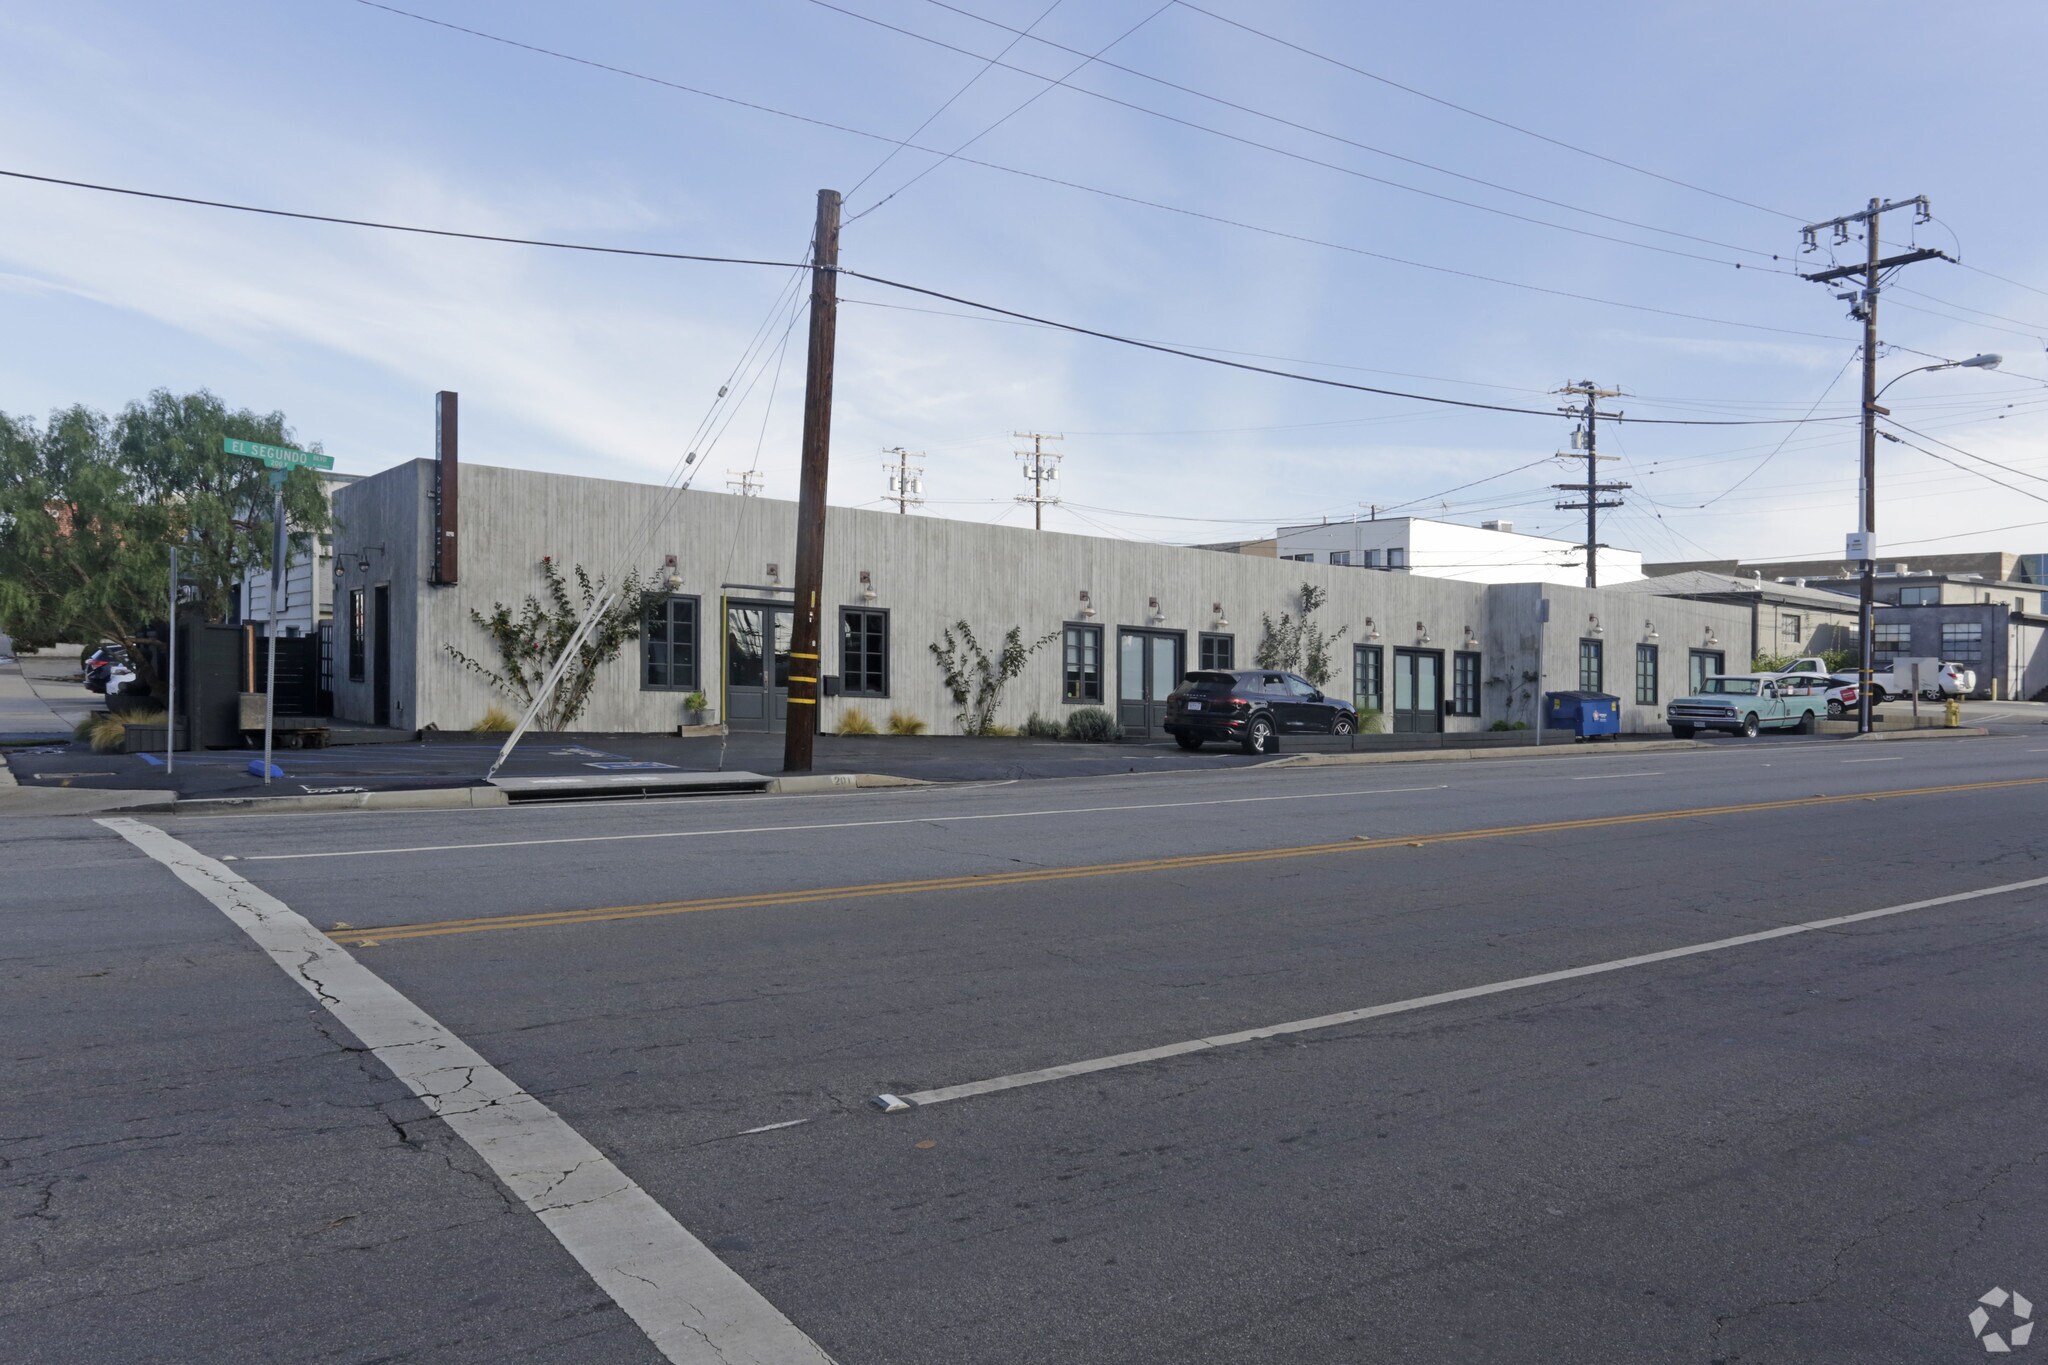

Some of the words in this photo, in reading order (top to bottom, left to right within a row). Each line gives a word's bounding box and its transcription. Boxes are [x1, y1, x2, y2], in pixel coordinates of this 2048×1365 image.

[232, 441, 246, 454] EL
[251, 445, 307, 464] SEGUNDO
[313, 455, 328, 463] BLVD
[834, 776, 850, 785] 201
